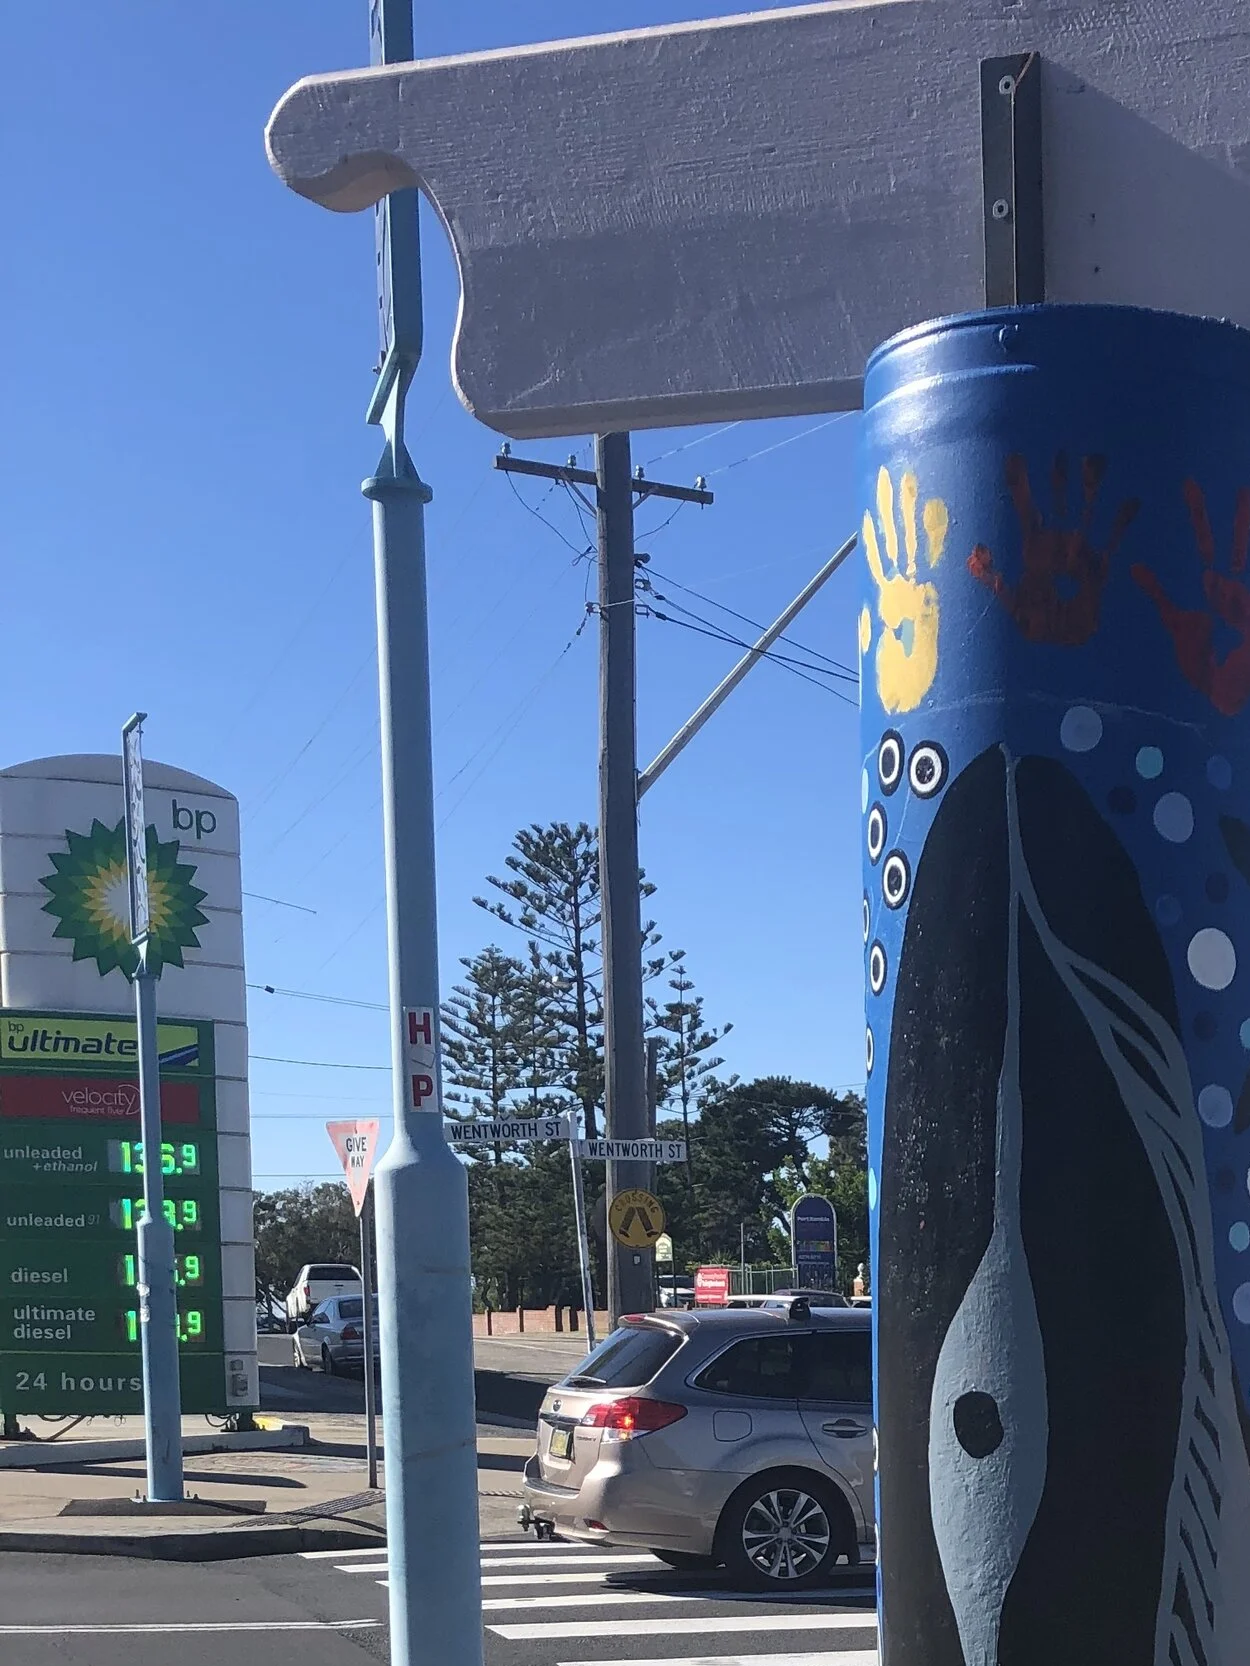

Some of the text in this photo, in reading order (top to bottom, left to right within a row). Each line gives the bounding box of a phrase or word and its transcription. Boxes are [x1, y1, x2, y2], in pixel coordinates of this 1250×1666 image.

[172, 798, 217, 840] bp
[8, 1021, 25, 1034] bp
[408, 1012, 432, 1045] H
[8, 1029, 138, 1056] ultimate
[411, 1075, 434, 1107] P
[62, 1087, 137, 1115] velocity
[451, 1121, 562, 1140] WENTWORTH ST
[3, 1146, 83, 1160] unleaded
[345, 1136, 368, 1153] GIVE
[588, 1141, 683, 1158] WENTWORTH ST
[32, 1160, 99, 1172] +ethanol
[350, 1155, 365, 1168] WAY
[6, 1213, 86, 1228] unleaded
[11, 1267, 69, 1284] diesel
[124, 1254, 200, 1286] 1.9
[13, 1304, 97, 1322] ultimate
[13, 1323, 72, 1340] diesel
[125, 1310, 202, 1342] 1.9
[16, 1371, 142, 1392] 24 hours
